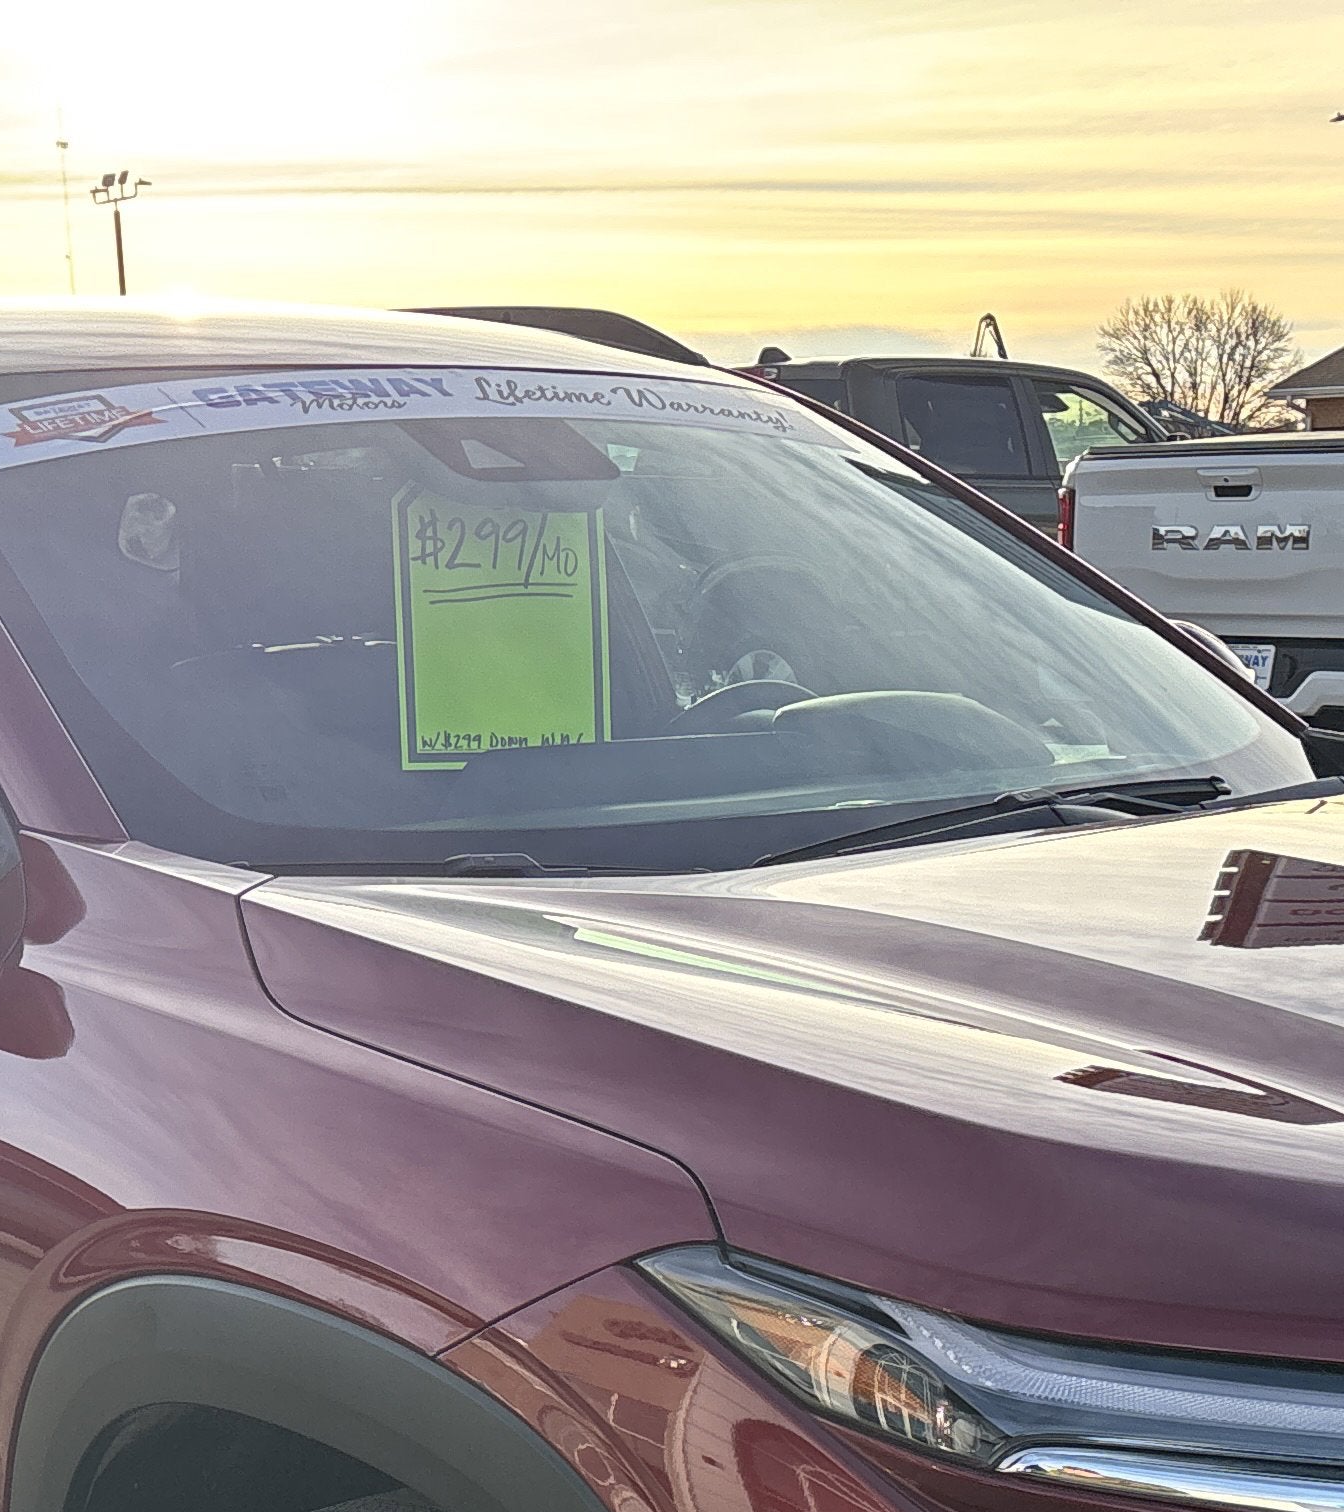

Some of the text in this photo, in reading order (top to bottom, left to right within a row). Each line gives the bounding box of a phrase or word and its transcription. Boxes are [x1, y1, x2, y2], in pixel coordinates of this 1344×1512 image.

[192, 377, 454, 409] GATEWAY
[288, 393, 408, 415] Motors
[474, 376, 795, 432] Lifetime Warranty!
[24, 406, 131, 435] LIFETIME
[1151, 523, 1311, 551] RAM
